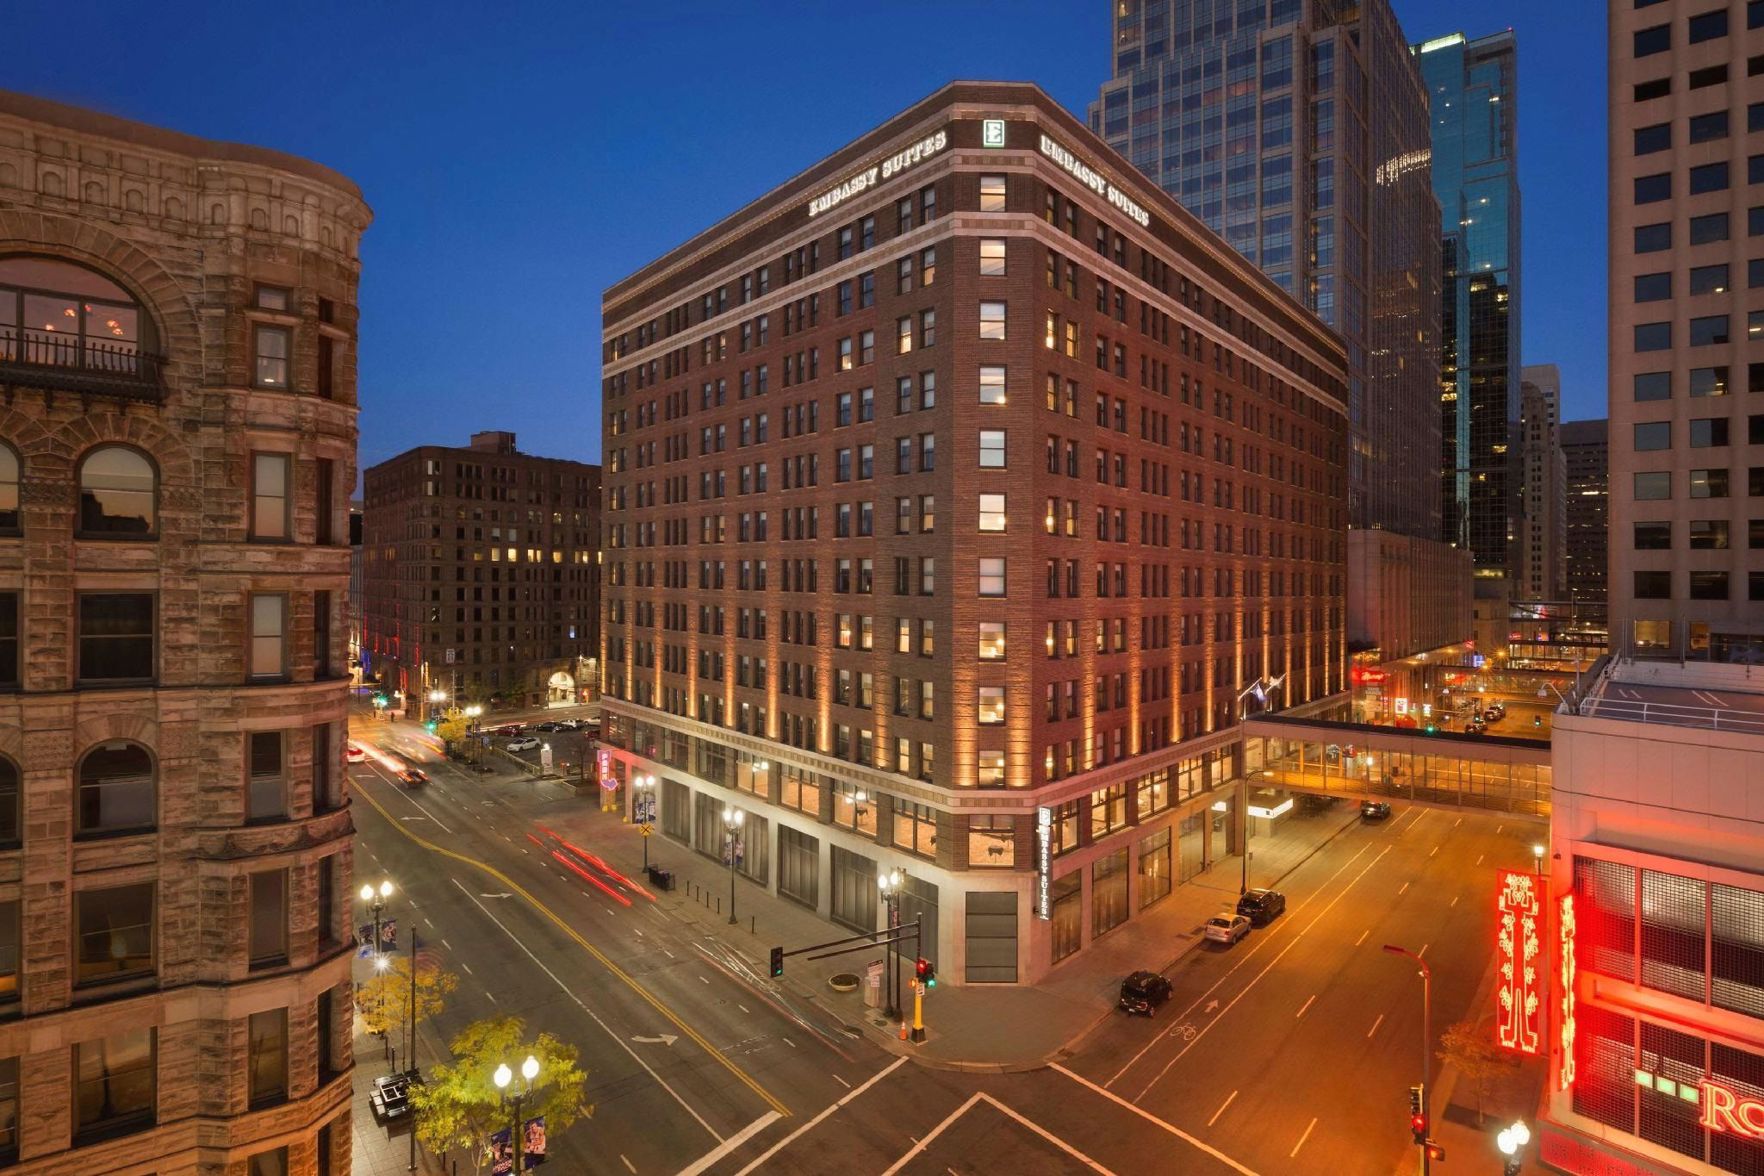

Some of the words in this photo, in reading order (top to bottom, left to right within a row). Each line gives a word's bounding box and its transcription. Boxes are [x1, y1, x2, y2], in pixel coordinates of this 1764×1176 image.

[986, 121, 1002, 143] E
[808, 167, 878, 216] EMBASSY
[882, 131, 947, 178] SUITES
[1040, 135, 1106, 193] EMBASSY
[1107, 185, 1149, 226] SUITES
[1040, 875, 1049, 914] SUITES
